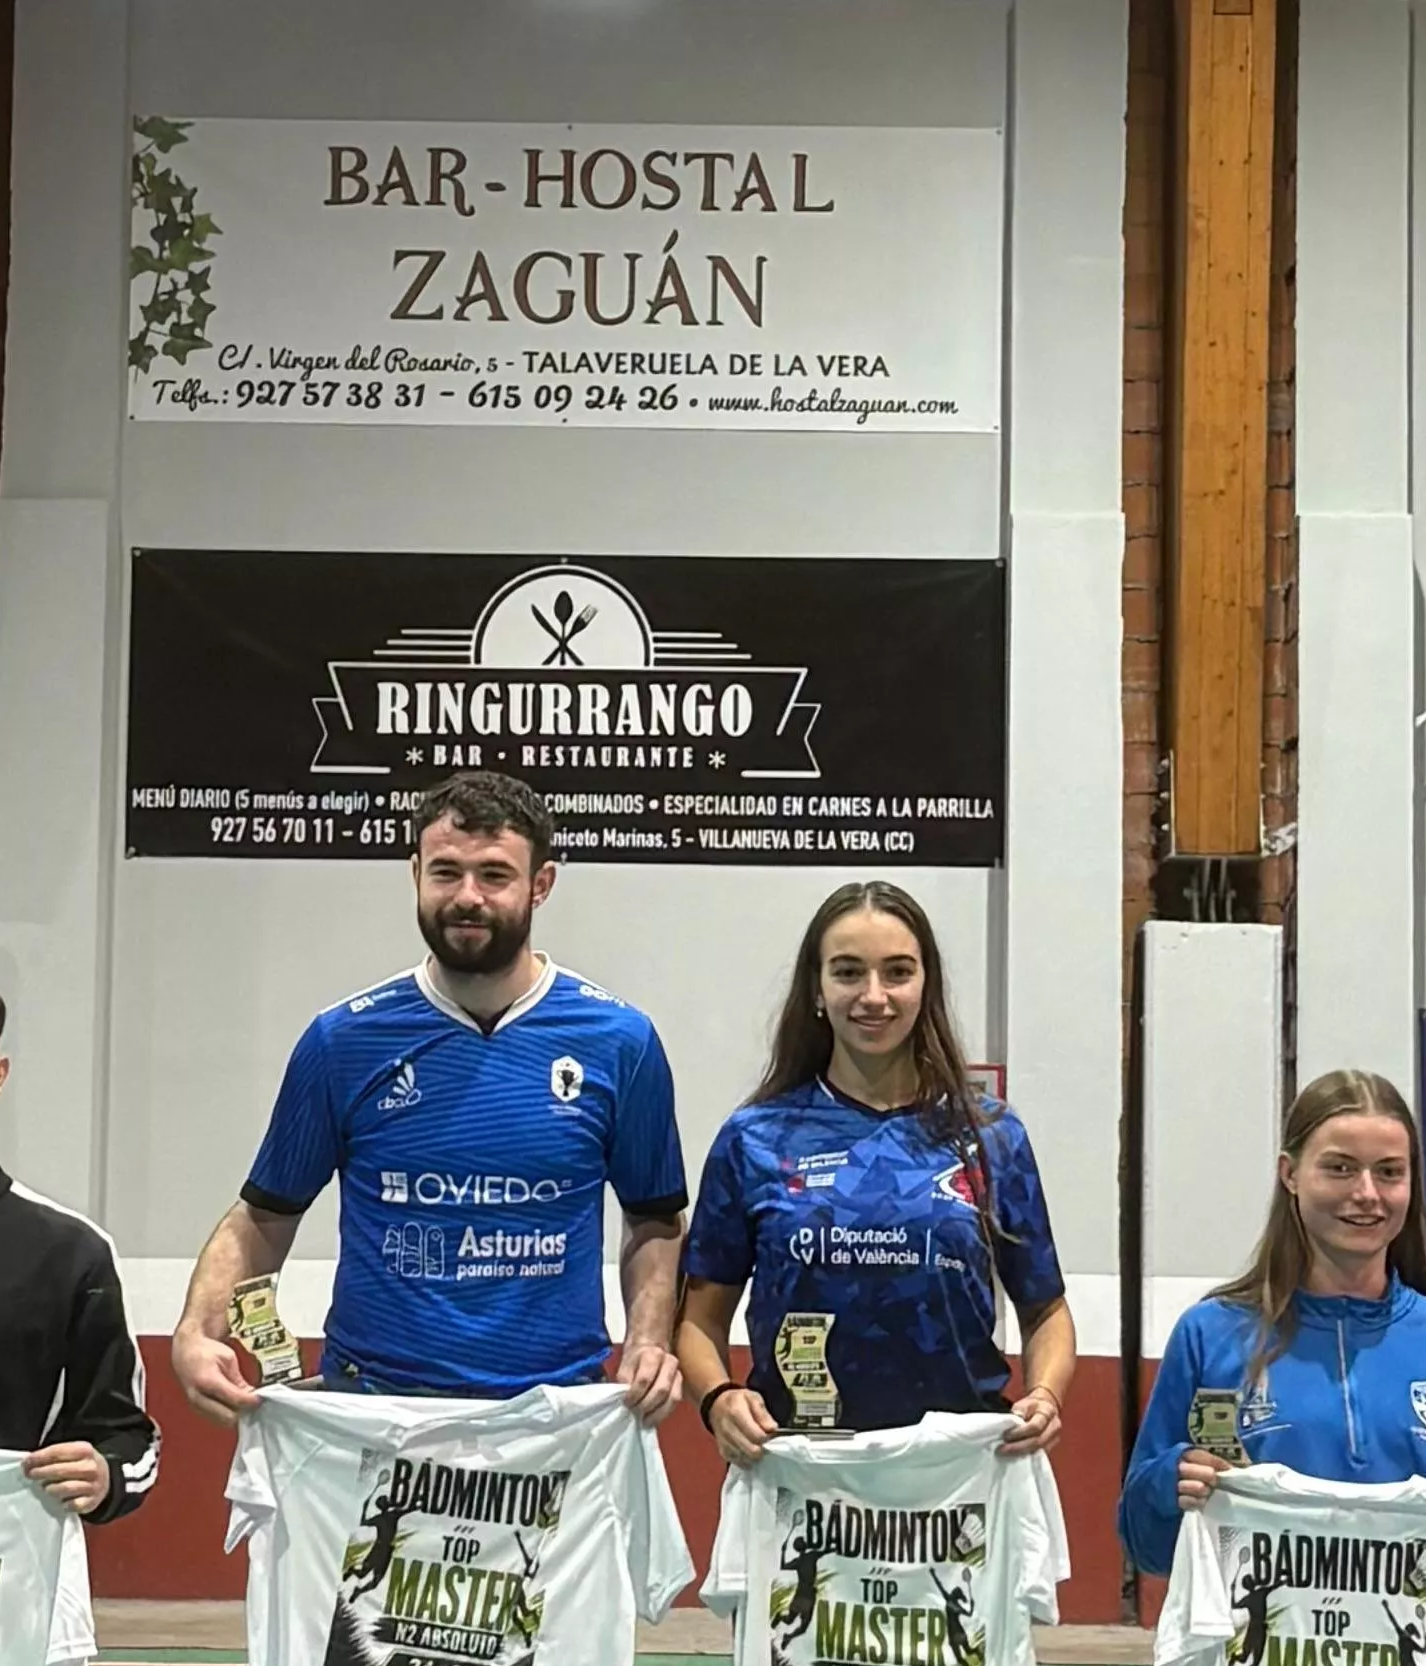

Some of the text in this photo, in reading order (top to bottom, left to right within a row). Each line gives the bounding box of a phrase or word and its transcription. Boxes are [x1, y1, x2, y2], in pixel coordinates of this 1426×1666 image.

[390, 229, 769, 327] ZAGUÁN
[269, 347, 341, 380] Virgen
[345, 344, 380, 371] del
[385, 347, 480, 375] Rosario,
[487, 358, 497, 372] 5
[524, 352, 718, 375] TALAVERUELA
[729, 354, 763, 376] DE
[773, 354, 808, 377] LA
[816, 355, 890, 377] VERA
[236, 381, 295, 408] 927
[303, 382, 340, 408] 57
[346, 381, 382, 409] 38
[395, 383, 425, 407] 31
[468, 382, 521, 409] 615
[534, 384, 572, 411] 09
[586, 385, 627, 411] 24
[638, 384, 678, 410] 26
[708, 386, 959, 425] www.hostalzaguan.com
[375, 679, 753, 737] RINGURRANGO
[434, 744, 695, 769] BAR RESTAURANTE
[132, 784, 993, 818] MENÚ DIARIO (5 menús a elegir) COMBINADOS ESPECIALIDAD EN CARNES A LA PARRILLA
[211, 818, 247, 842] 927
[253, 818, 276, 842] 56
[283, 818, 305, 842] 70
[313, 818, 334, 843] 11
[360, 819, 395, 844] 615
[550, 830, 599, 847] niceto
[672, 830, 681, 848] 5
[699, 829, 791, 849] VILLANUEVA
[795, 831, 813, 849] DE
[818, 832, 836, 850] LA
[840, 832, 879, 850] VERA
[885, 831, 914, 851] (CC)
[415, 1173, 562, 1205] OVIEDO
[458, 1226, 567, 1258] Asturias
[830, 1227, 907, 1245] Diputació
[519, 1260, 565, 1277] natural
[831, 1250, 919, 1265] de València
[442, 1536, 480, 1564] TOP
[383, 1558, 524, 1633] MASTER
[861, 1578, 898, 1604] TOP
[1312, 1609, 1350, 1637] TOP
